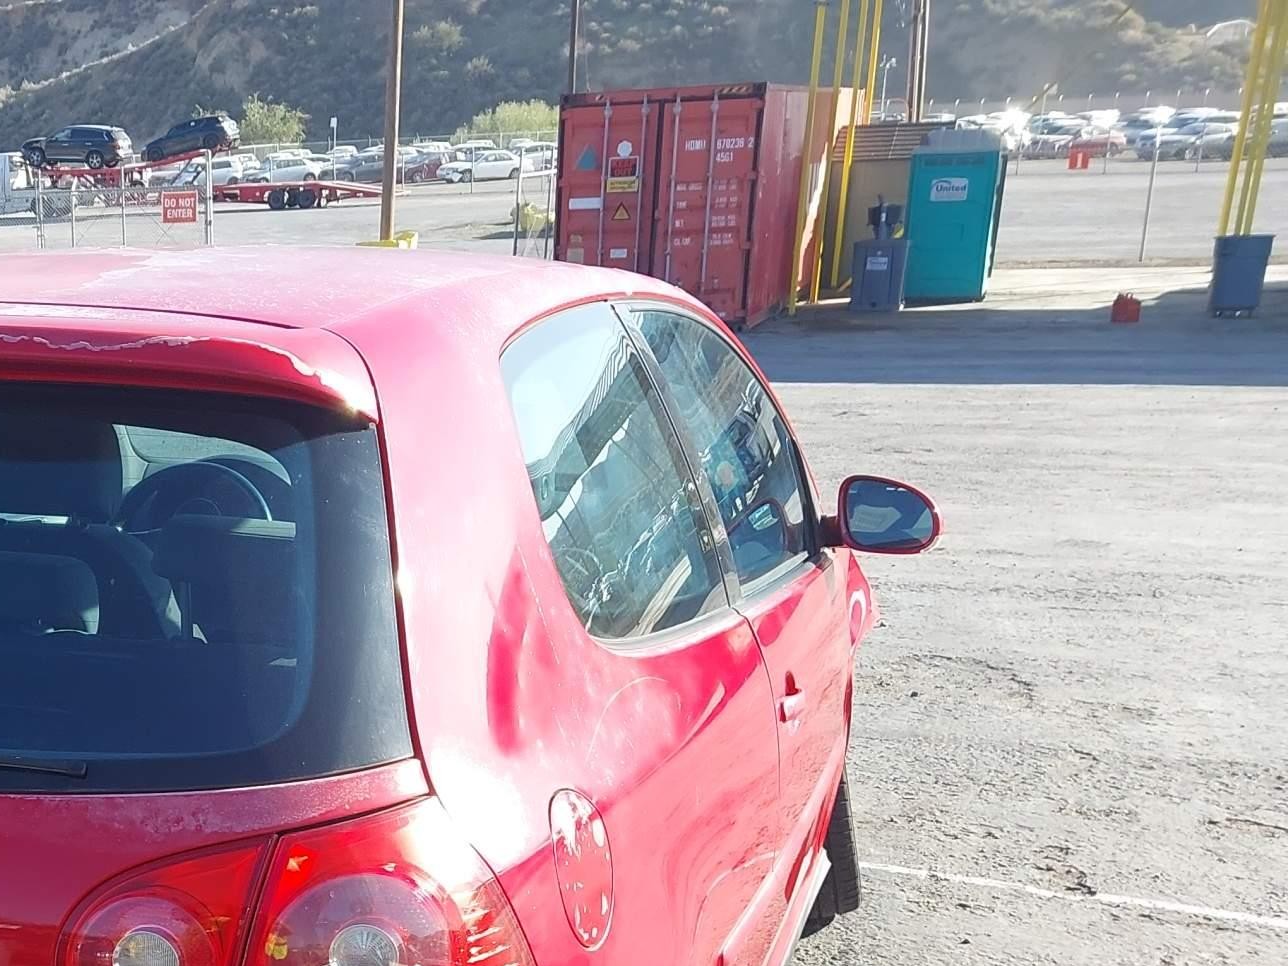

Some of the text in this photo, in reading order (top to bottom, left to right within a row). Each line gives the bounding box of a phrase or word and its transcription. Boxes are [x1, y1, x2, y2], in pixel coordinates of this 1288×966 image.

[936, 183, 967, 193] United
[164, 197, 195, 208] DO NOT
[166, 208, 193, 218] ENTER
